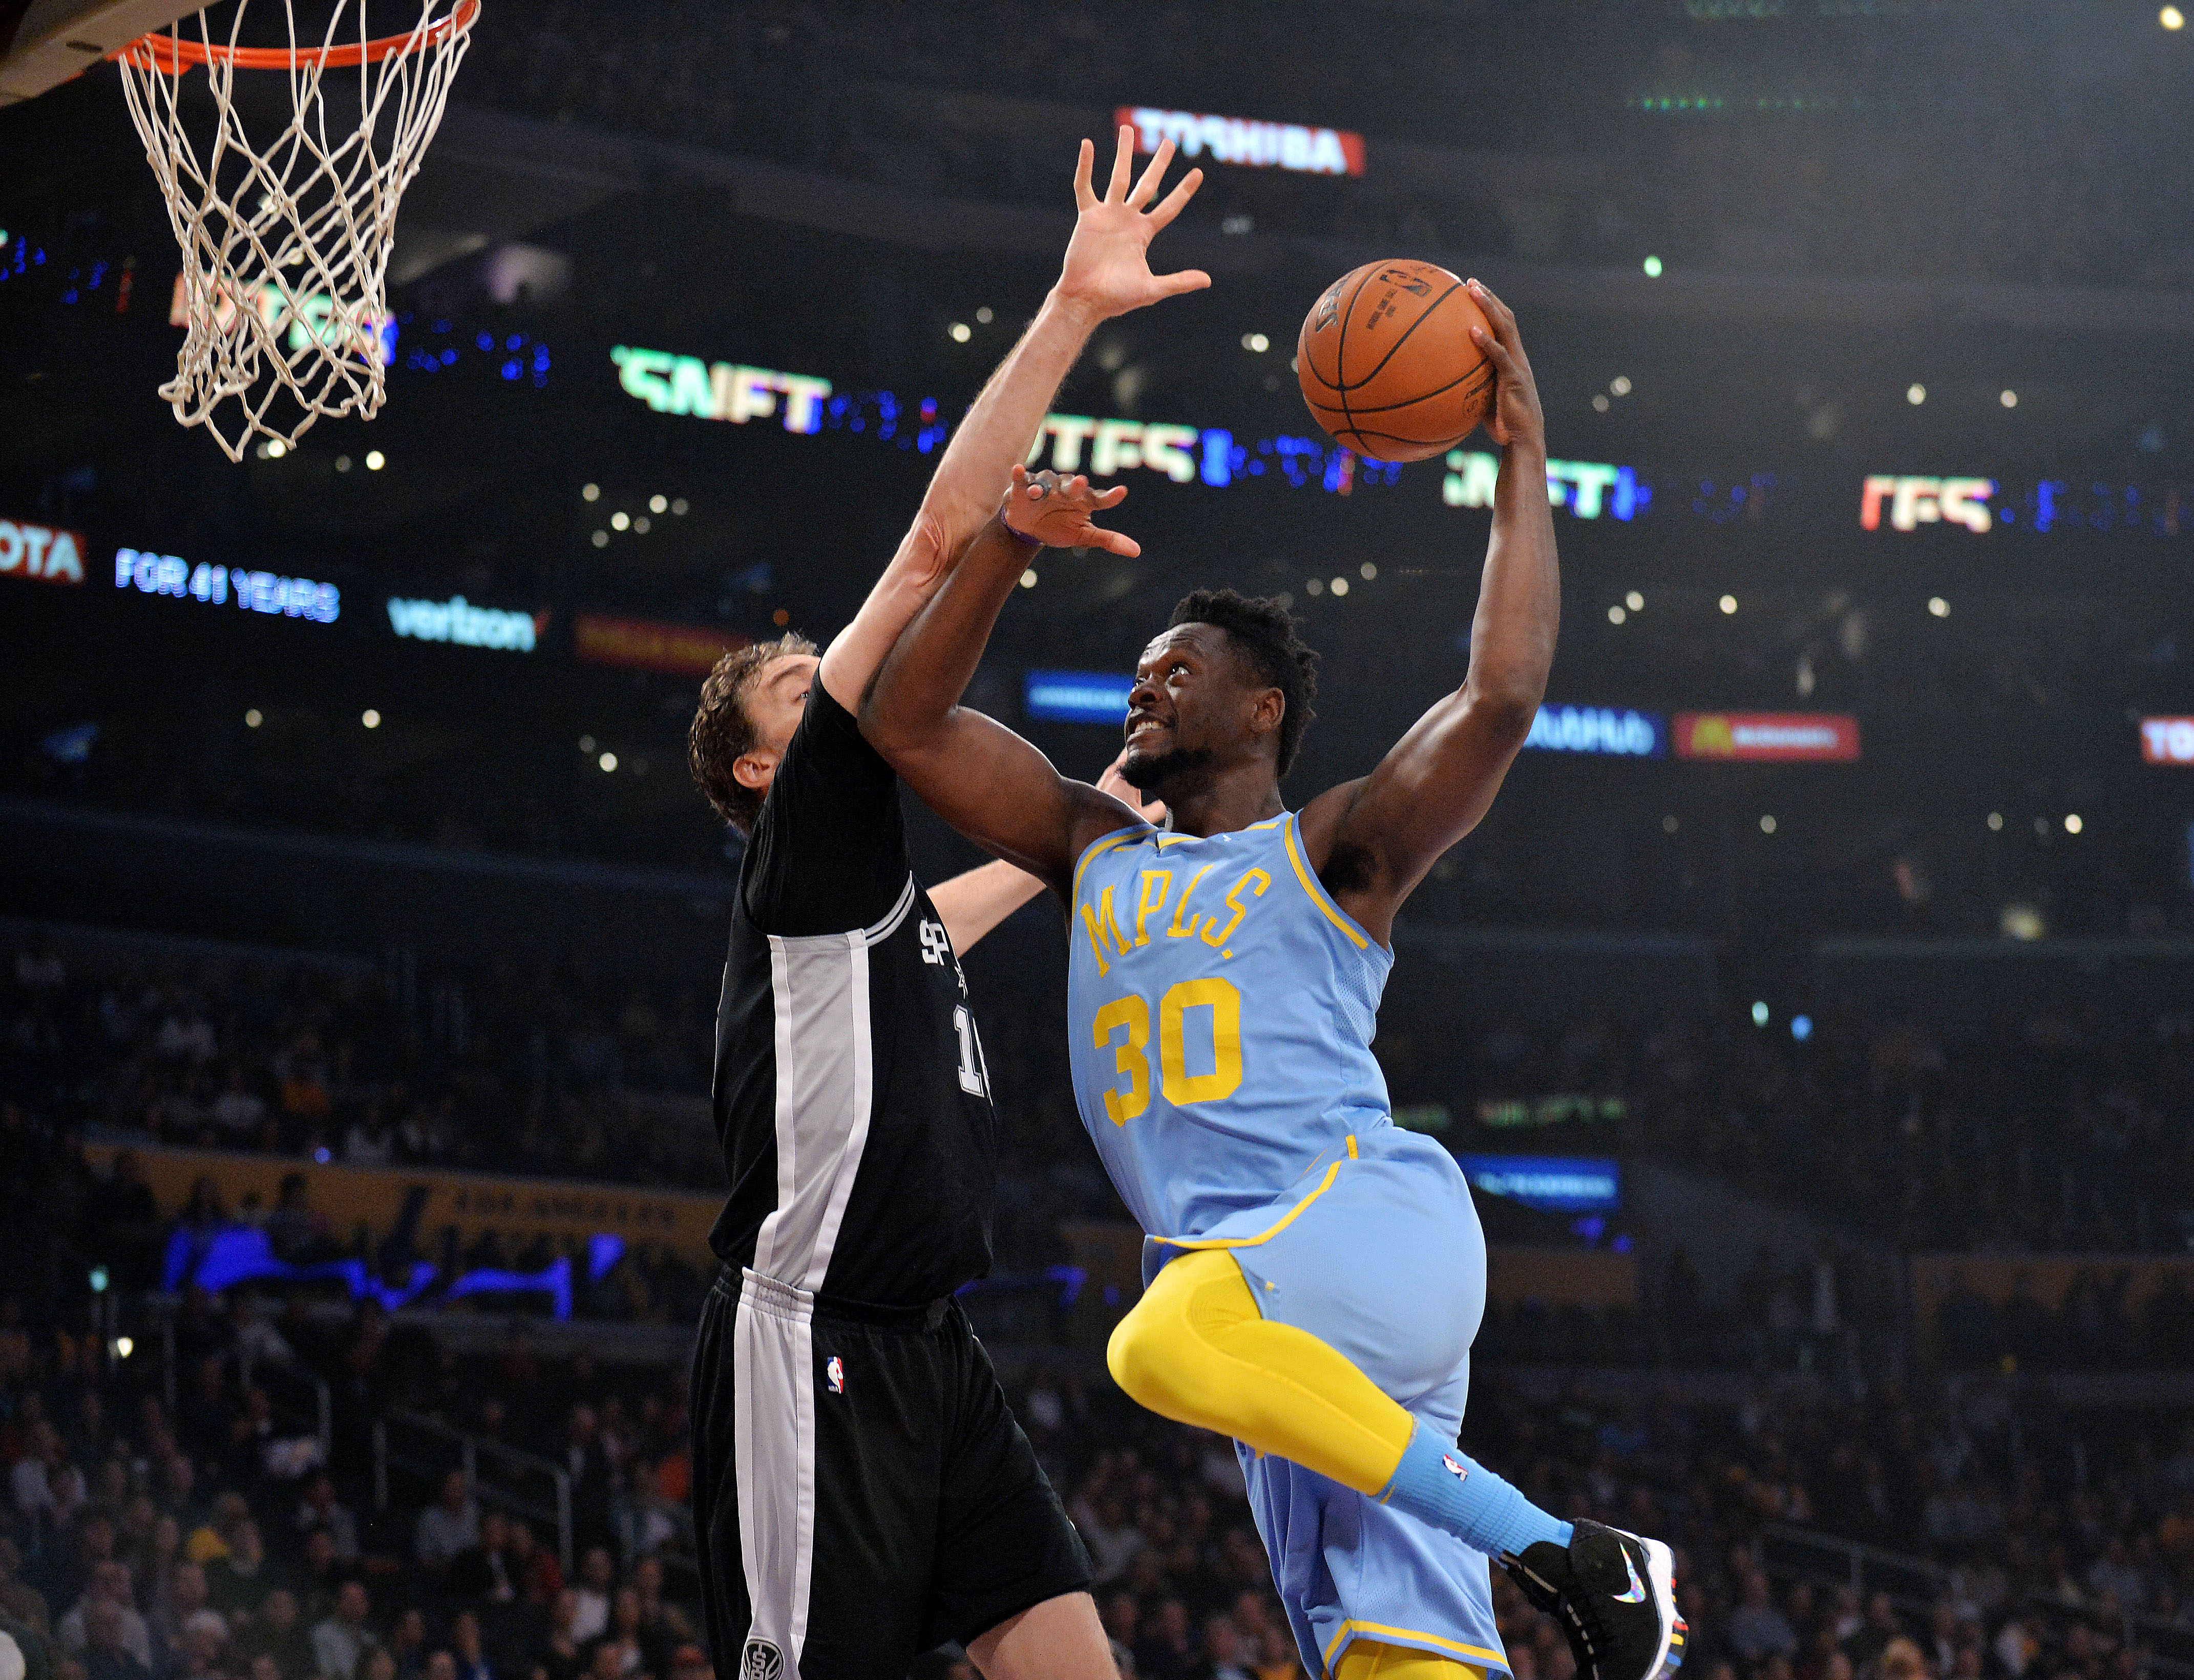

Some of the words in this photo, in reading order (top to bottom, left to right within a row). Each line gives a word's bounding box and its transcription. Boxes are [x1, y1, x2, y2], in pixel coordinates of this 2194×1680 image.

[1131, 108, 1347, 175] TOSHIBA
[115, 548, 188, 598] FOR
[189, 562, 227, 604] 41
[230, 568, 340, 623] YEARS
[387, 595, 536, 654] verizon
[1080, 864, 1271, 978] MPLS.
[953, 1004, 993, 1107] 1
[1092, 977, 1242, 1127] 30
